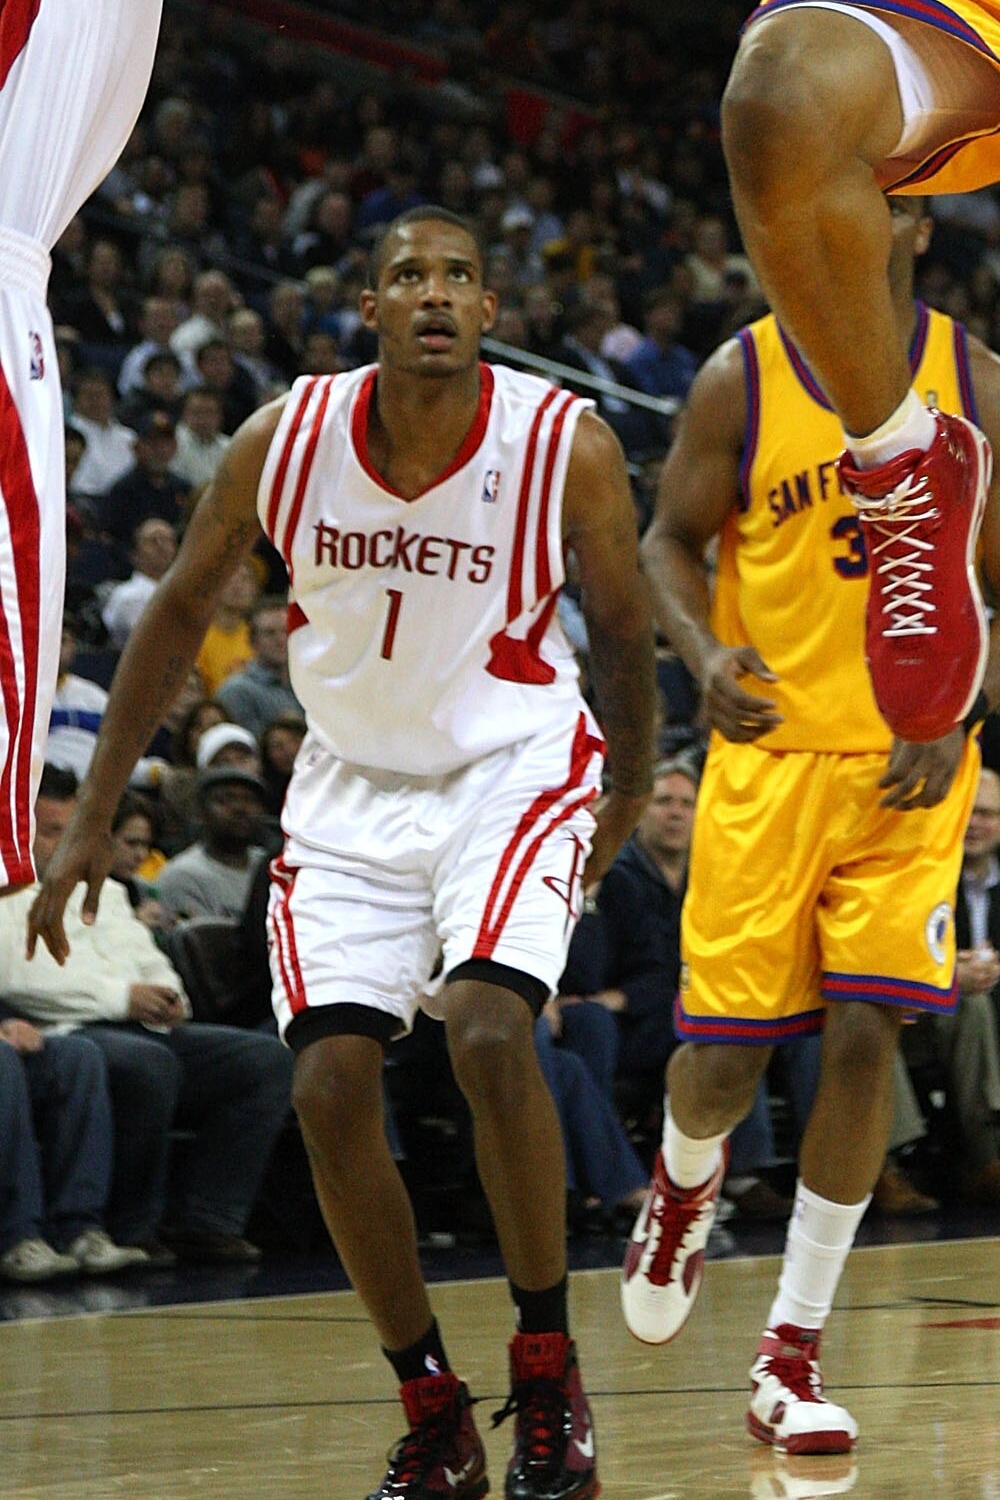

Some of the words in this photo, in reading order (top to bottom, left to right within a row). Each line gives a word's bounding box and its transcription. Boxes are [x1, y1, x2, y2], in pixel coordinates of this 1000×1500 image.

[768, 470, 813, 528] SAN
[313, 519, 495, 584] ROCKETS
[380, 588, 403, 661] 1
